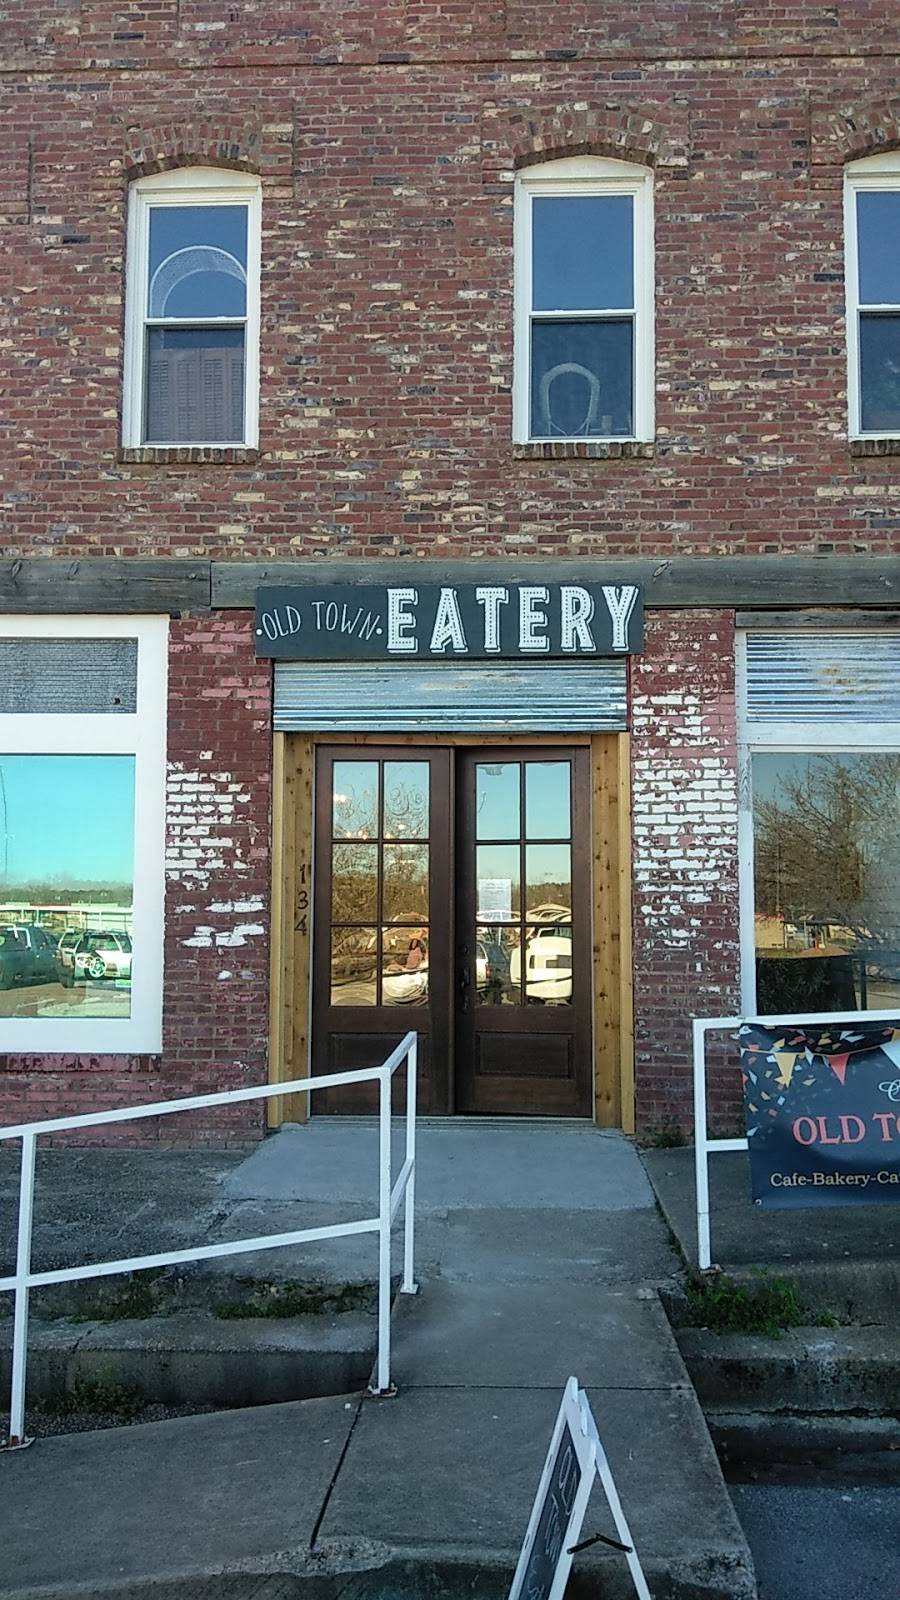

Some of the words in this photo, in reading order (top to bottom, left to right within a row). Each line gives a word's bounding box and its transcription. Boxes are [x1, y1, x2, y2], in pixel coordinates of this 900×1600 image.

[261, 604, 302, 641] OLD
[311, 600, 381, 641] TOWN
[386, 585, 637, 654] EATERY
[793, 1115, 866, 1145] OLD
[872, 1111, 900, 1142] T
[770, 1171, 900, 1187] Cafe-Bakery-Ca
